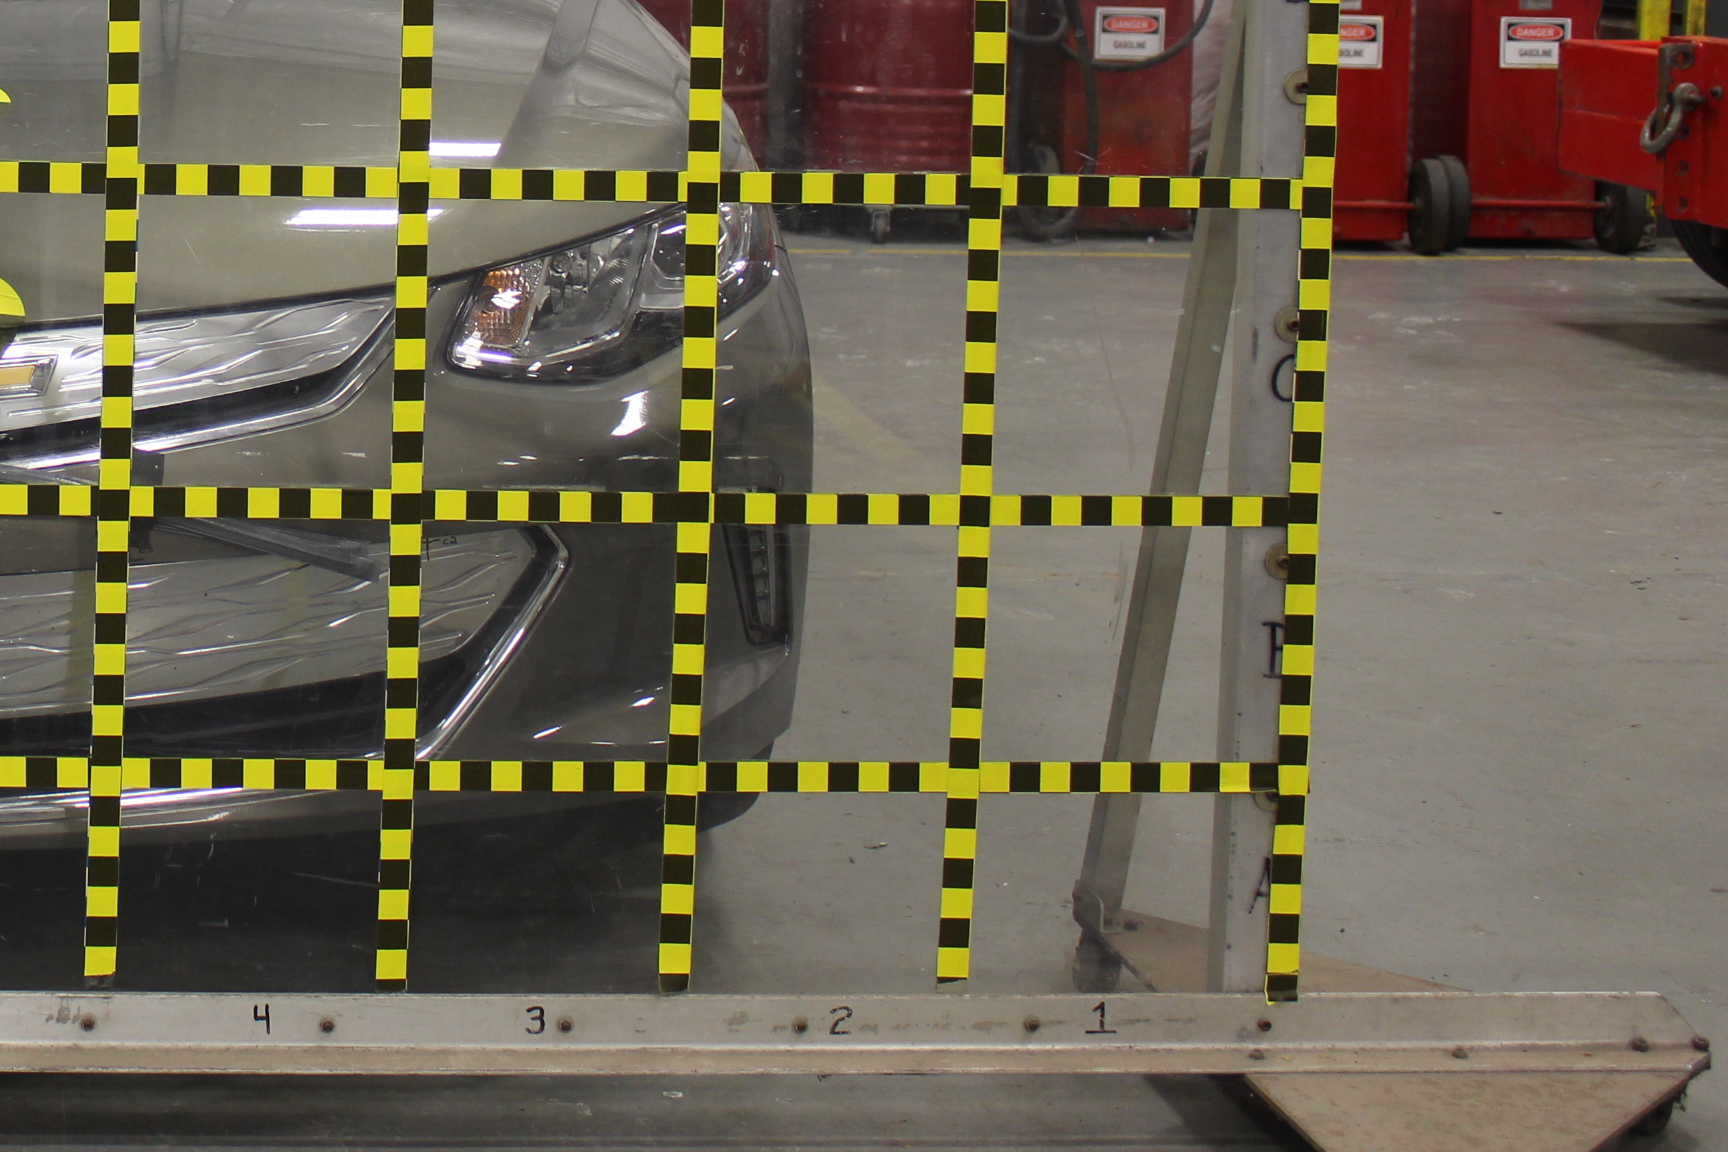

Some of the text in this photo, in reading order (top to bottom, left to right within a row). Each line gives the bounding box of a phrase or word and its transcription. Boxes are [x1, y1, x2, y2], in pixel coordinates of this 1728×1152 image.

[1112, 20, 1149, 28] DANGER
[1517, 28, 1554, 36] DANGER
[1519, 49, 1552, 57] GASOLINE
[253, 1004, 271, 1035] 4
[525, 1005, 547, 1035] 3
[829, 1006, 853, 1035] 2
[1084, 1001, 1117, 1035] 1
